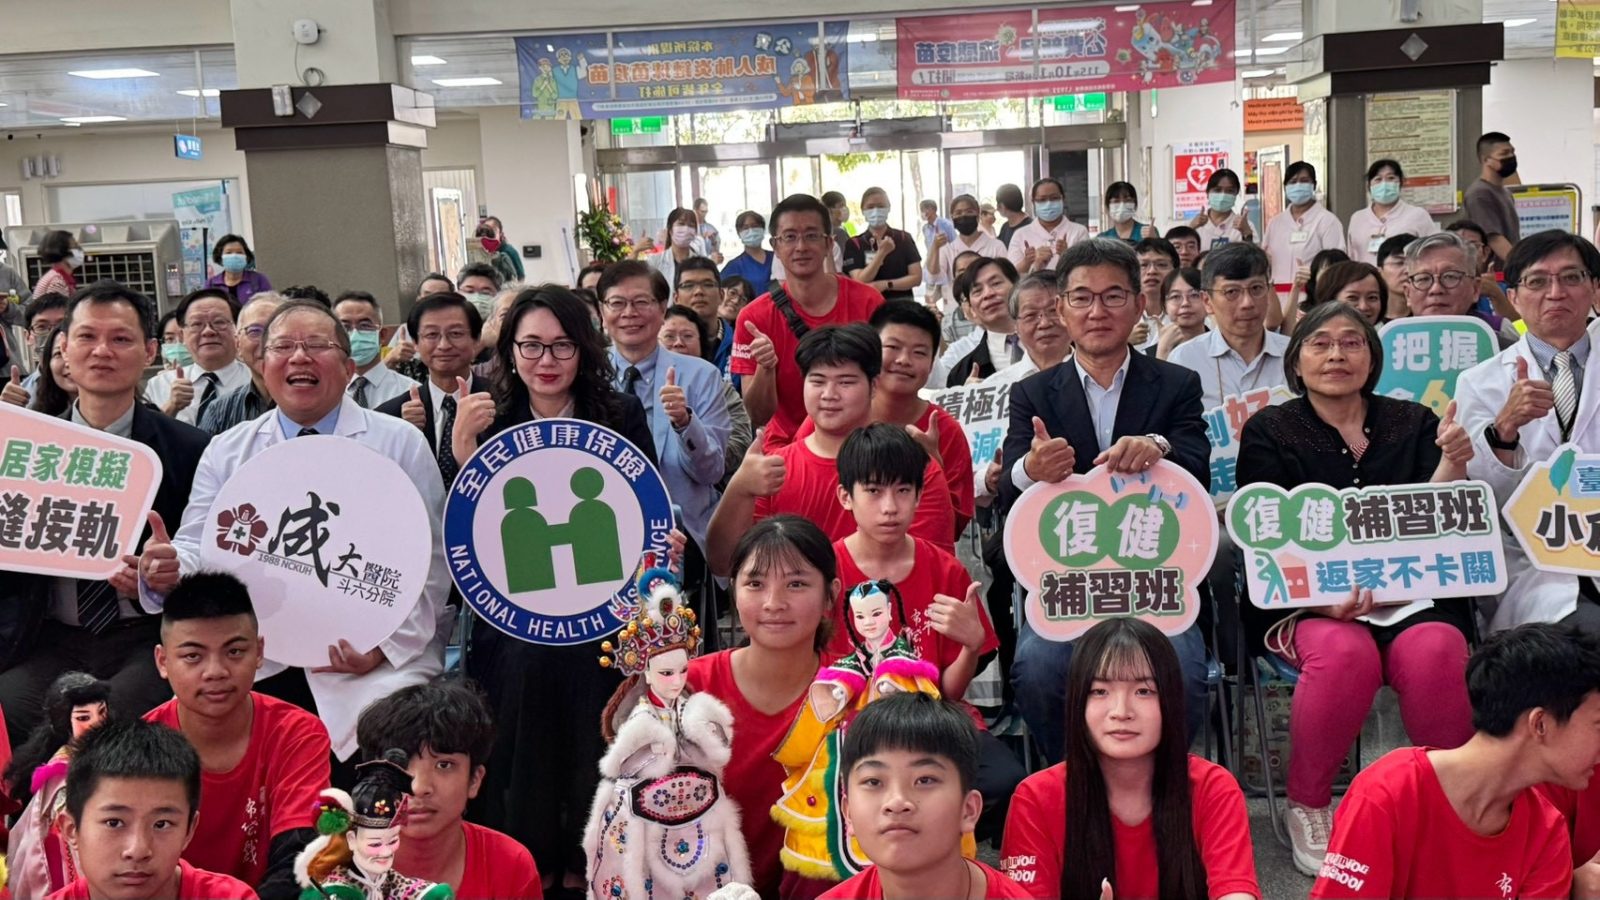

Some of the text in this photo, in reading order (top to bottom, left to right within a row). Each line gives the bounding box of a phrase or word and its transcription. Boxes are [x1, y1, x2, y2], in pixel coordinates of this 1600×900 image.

[1190, 156, 1213, 166] AED
[1391, 329, 1478, 372] 把握
[1, 440, 132, 490] 居家模擬
[456, 424, 646, 502] 全民健康保險
[1053, 500, 1166, 560] 復健
[1244, 488, 1490, 543] 復健補習班
[257, 552, 314, 577] 1988 NCKUH
[1316, 551, 1496, 594] 返家不卡關
[337, 577, 397, 608] 斗六分院
[450, 544, 518, 630] NATIONAL
[527, 613, 606, 639] HEALTH
[1043, 569, 1181, 617] 補習班
